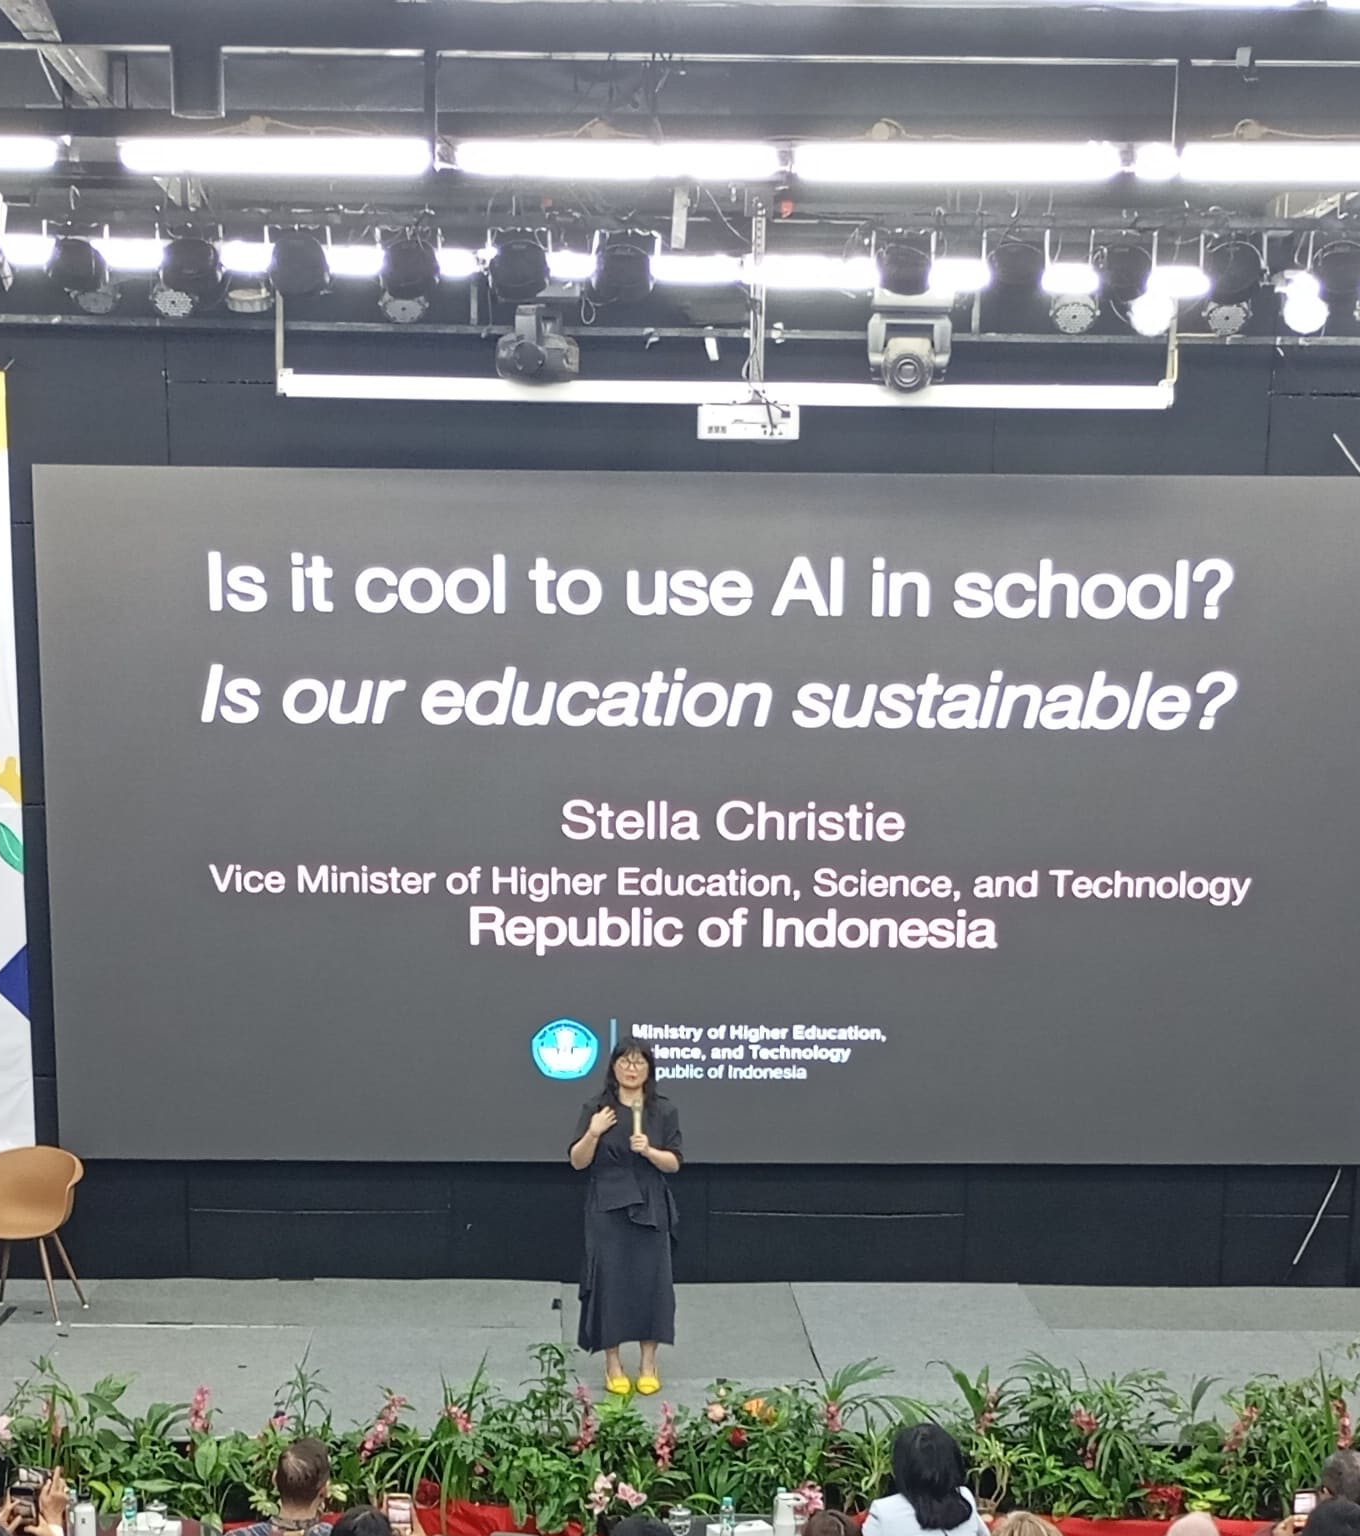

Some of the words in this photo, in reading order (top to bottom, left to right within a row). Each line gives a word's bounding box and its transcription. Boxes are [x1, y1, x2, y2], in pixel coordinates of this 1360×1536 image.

[208, 550, 268, 612] Is
[291, 552, 334, 612] it
[355, 553, 506, 614] cool
[528, 557, 603, 615] to
[627, 568, 754, 616] use
[771, 553, 845, 616] AI
[872, 556, 931, 617] in
[953, 558, 1235, 620] school?
[201, 664, 261, 723] Is
[282, 678, 406, 724] our
[421, 666, 773, 727] education
[792, 670, 1238, 730] sustainable?
[562, 799, 700, 840] Stella
[716, 800, 905, 842] Christie
[209, 864, 285, 893] Vice
[298, 865, 436, 894] Minister
[446, 866, 481, 894] of
[492, 866, 607, 902] Higher
[618, 867, 800, 901] Education,
[813, 868, 960, 902] Science,
[973, 870, 1038, 898] and
[1049, 870, 1251, 906] Technology
[470, 906, 683, 956] Republic
[698, 907, 748, 947] of
[763, 908, 998, 949] Indonesia
[632, 1024, 703, 1042] Ministry
[707, 1025, 726, 1039] of
[730, 1025, 788, 1042] Higher
[793, 1025, 886, 1042] Education,
[651, 1044, 706, 1061] ience,
[711, 1045, 744, 1059] and
[749, 1045, 851, 1063] Technology
[656, 1064, 703, 1081] public
[707, 1064, 724, 1079] of
[728, 1065, 807, 1079] Indonesia
